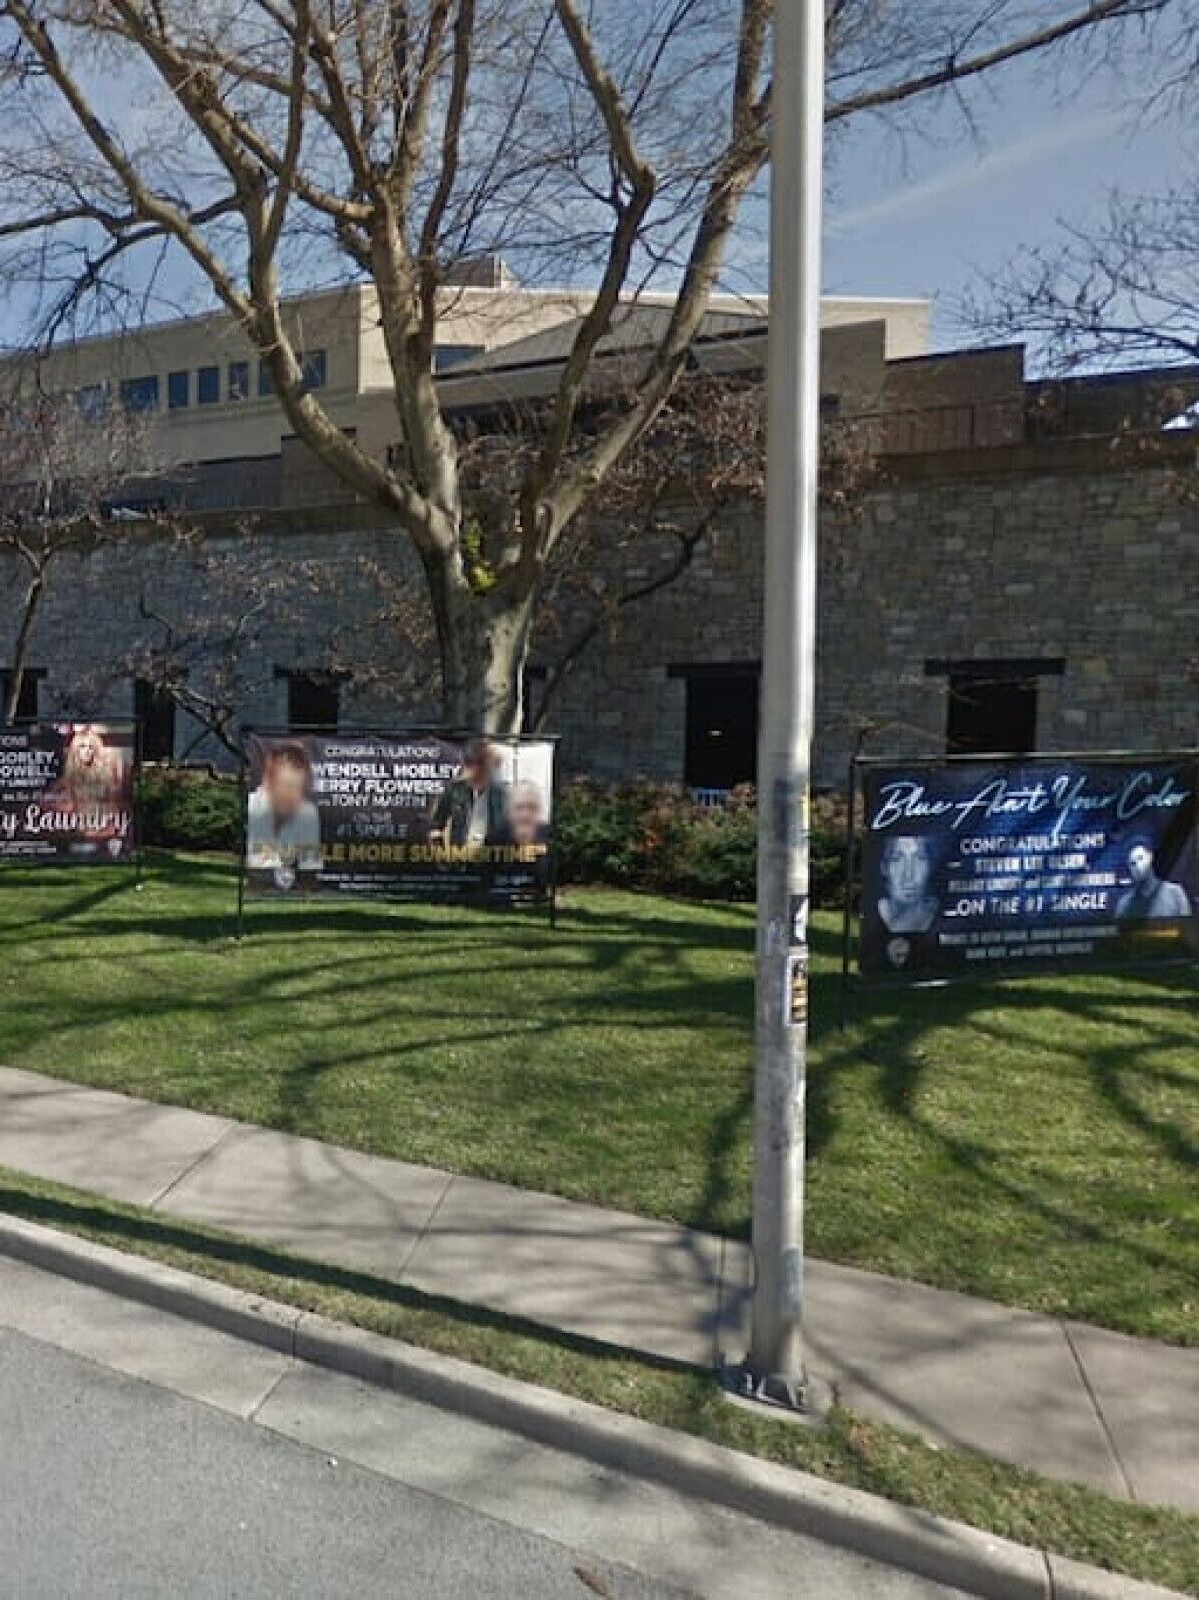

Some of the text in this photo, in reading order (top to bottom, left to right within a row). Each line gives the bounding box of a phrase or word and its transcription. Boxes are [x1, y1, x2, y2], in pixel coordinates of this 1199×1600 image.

[312, 763, 462, 778] WENDELL MOBLEY
[364, 779, 446, 794] FLOWERS
[870, 781, 952, 830] Blue
[1051, 773, 1118, 846] Your
[1116, 771, 1192, 820] Color
[24, 803, 131, 837] Laundry
[349, 843, 405, 863] MORE
[991, 896, 1021, 915] THE
